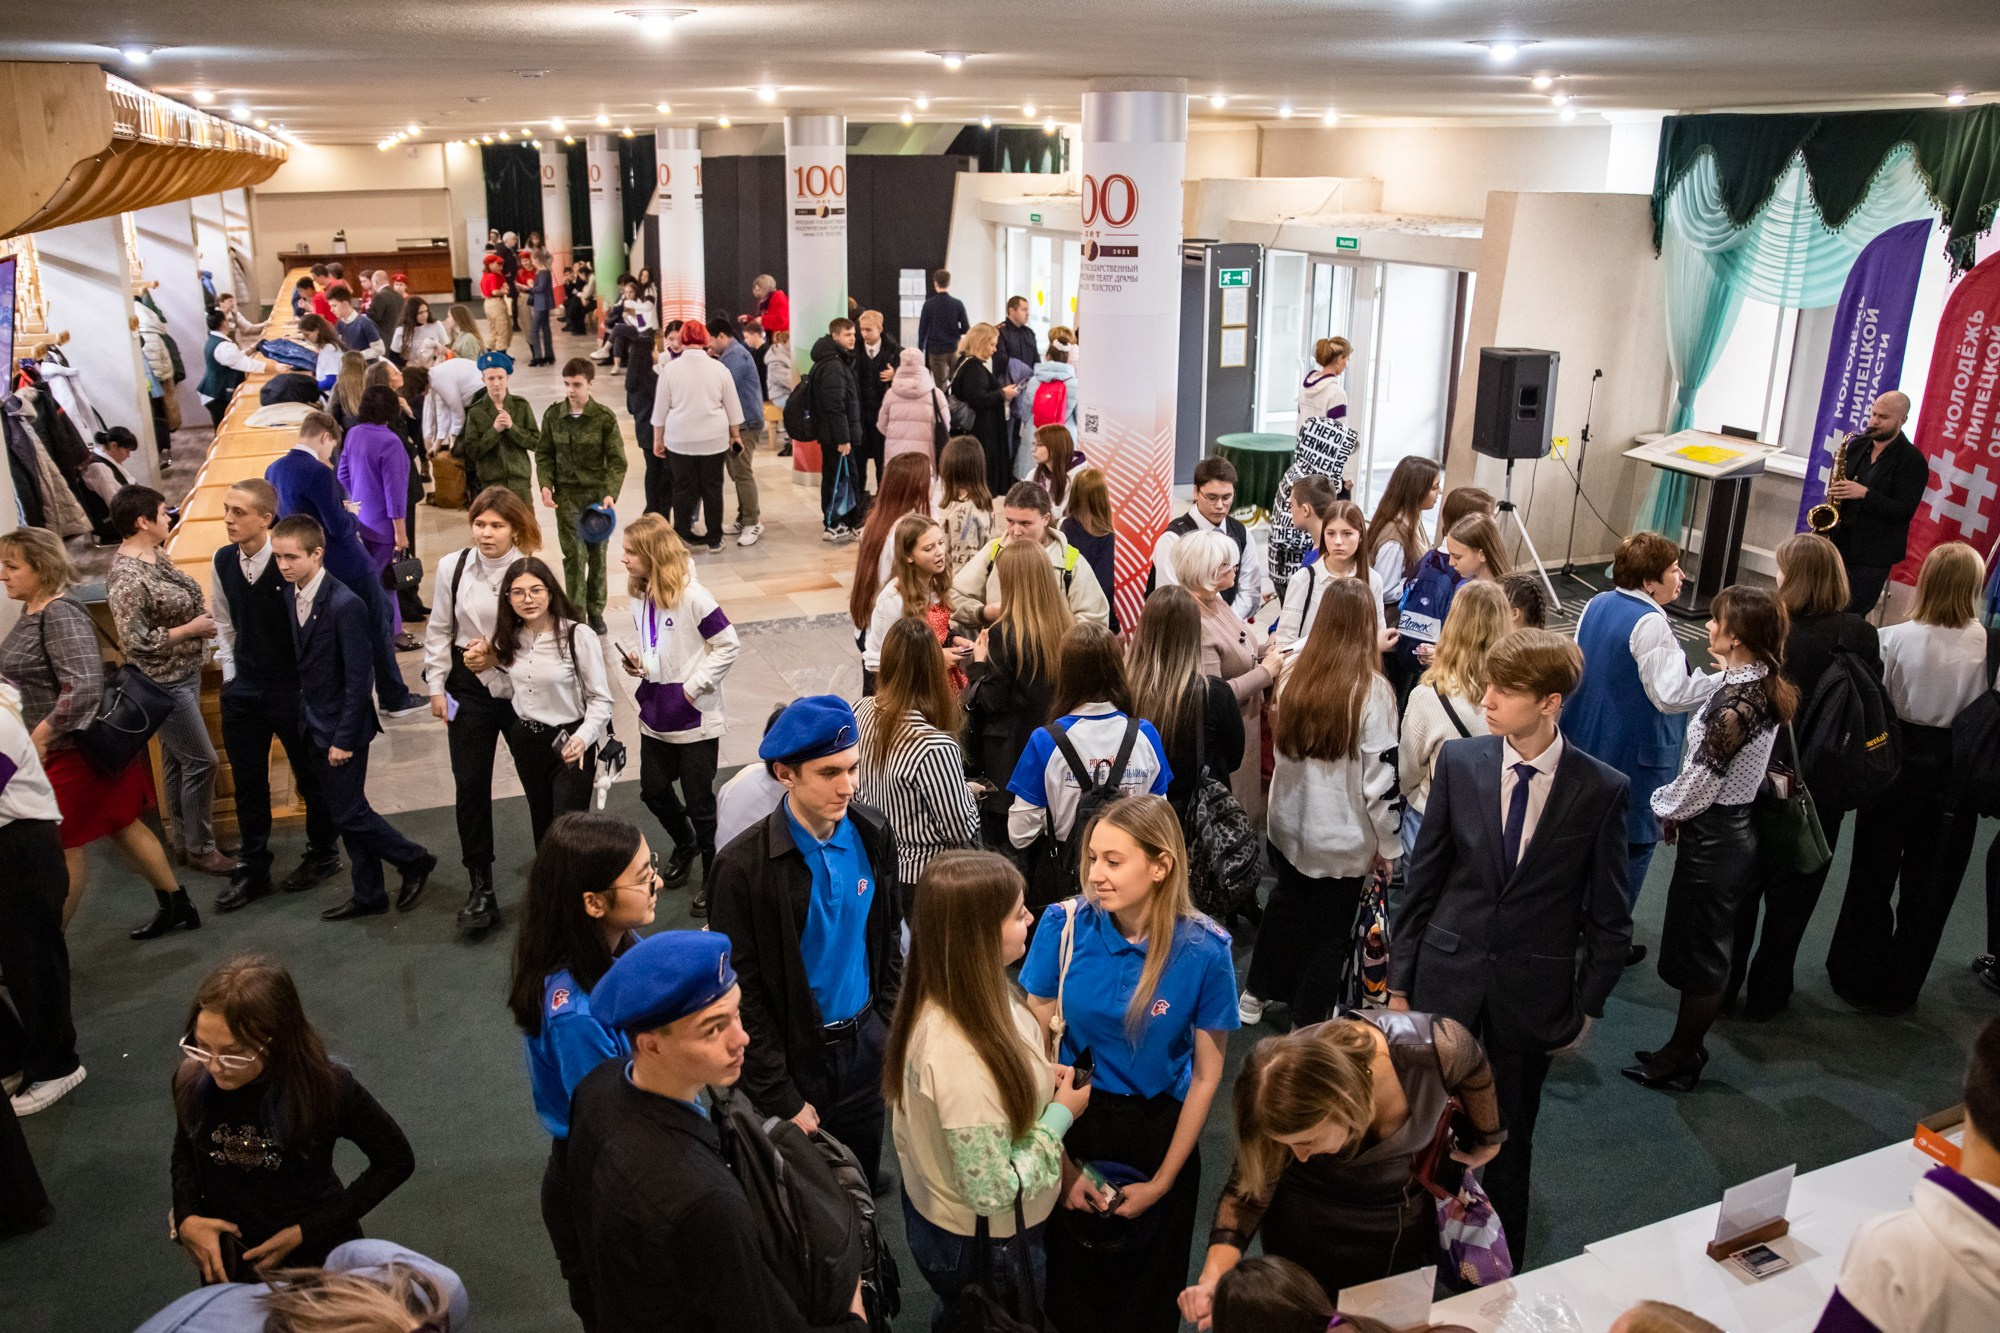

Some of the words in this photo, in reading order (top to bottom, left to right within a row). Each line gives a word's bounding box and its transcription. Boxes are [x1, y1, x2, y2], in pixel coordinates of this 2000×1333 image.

[793, 165, 845, 198] 100
[1096, 274, 1114, 282] ТЕАТР
[1114, 275, 1139, 283] ДРАМЫ
[1849, 308, 1880, 426] ЛИПЕЦКОЙ
[1942, 309, 1985, 439] МОЛОДЁЖЬ
